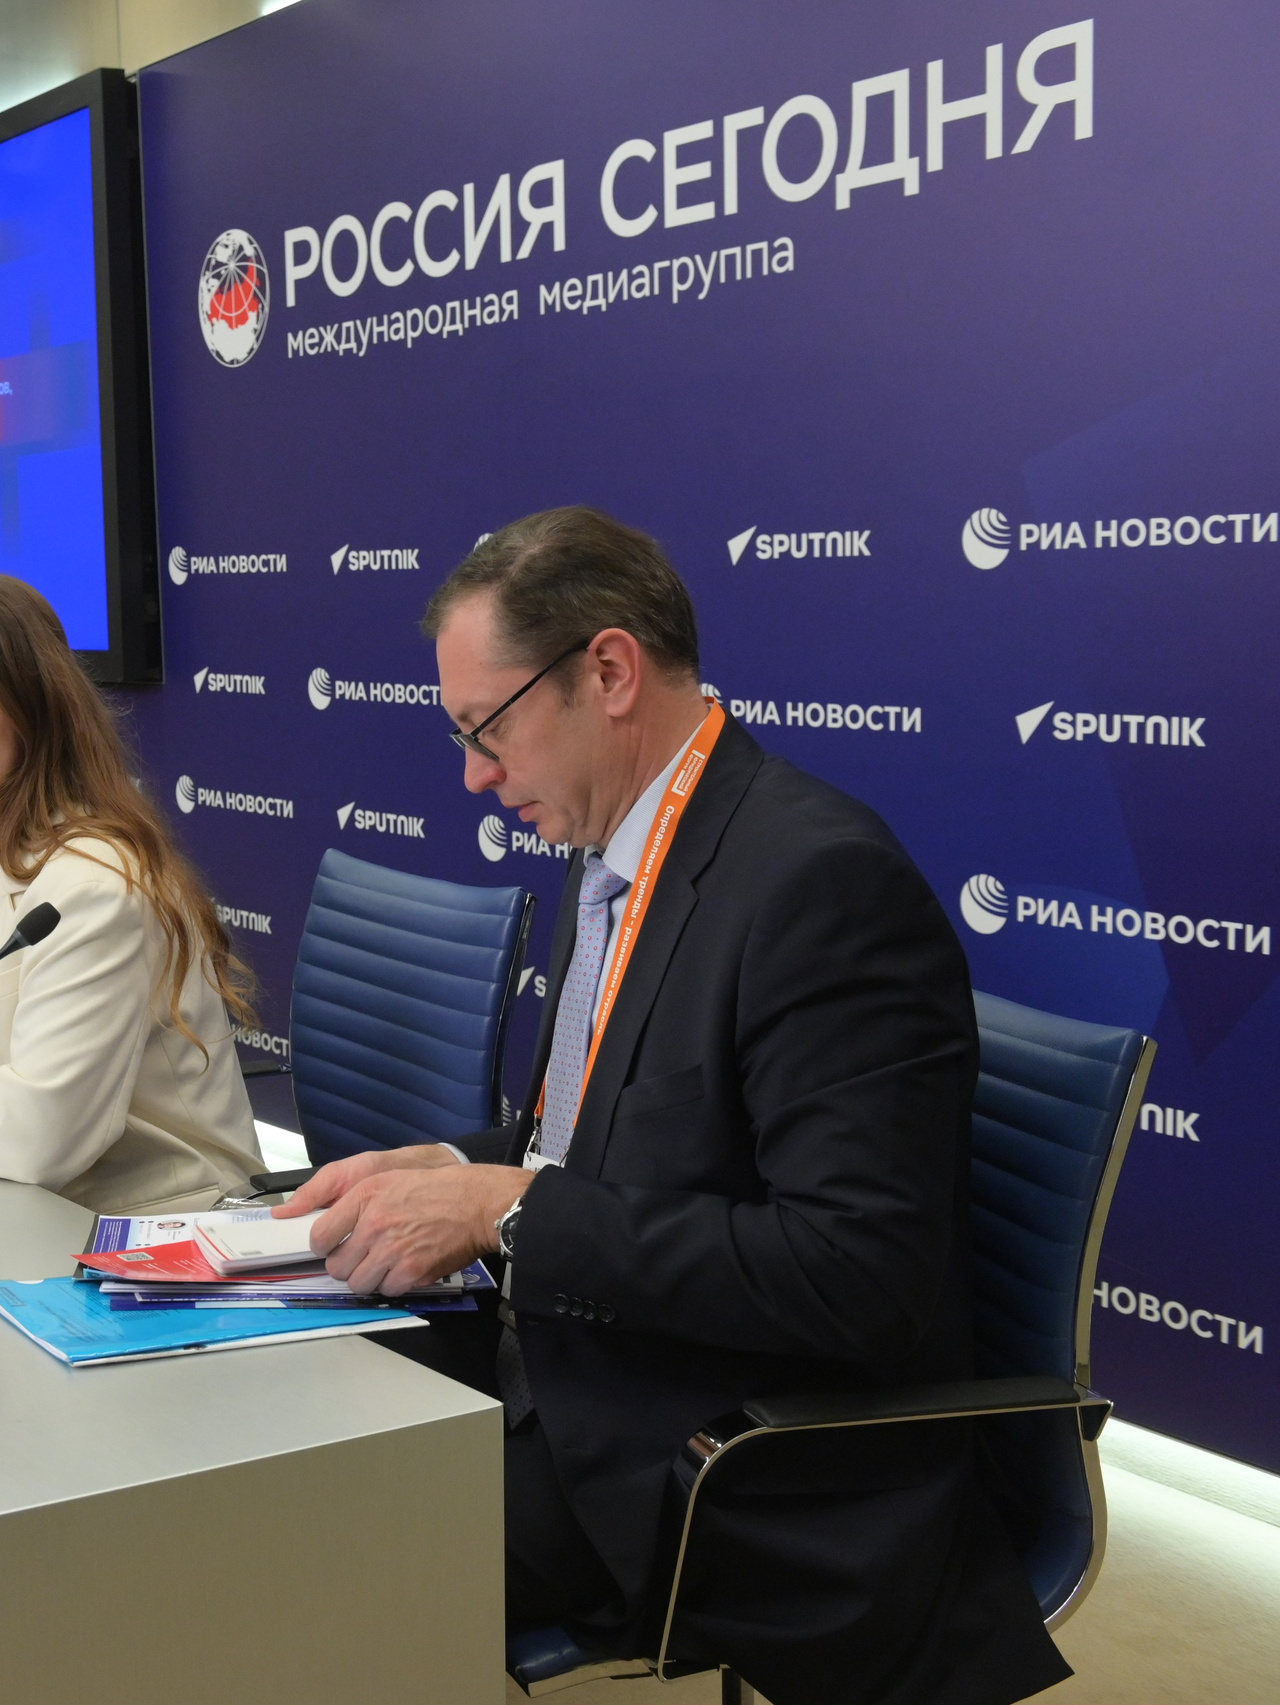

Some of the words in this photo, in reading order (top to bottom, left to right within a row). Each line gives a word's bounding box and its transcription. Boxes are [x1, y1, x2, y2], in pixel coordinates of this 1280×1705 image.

[284, 158, 566, 308] РОССИЯ
[600, 18, 1095, 238] СЕГОДНЯ
[287, 289, 519, 359] международная
[539, 236, 795, 315] медиагруппа
[755, 530, 872, 560] SPUTNIK
[1019, 521, 1087, 551] РИА
[1095, 512, 1279, 549] НОВОСТИ
[190, 556, 217, 574] РИА
[219, 554, 287, 574] НОВОСТИ
[348, 548, 420, 571] SPUTNIK
[207, 673, 266, 695] SPUTNIK
[335, 680, 368, 702] РИА
[370, 683, 443, 706] НОВОСТ
[730, 699, 781, 725] РИА
[786, 701, 922, 733] НОВОСТИ
[1052, 711, 1207, 747] SPUTNIK
[197, 787, 224, 809] РИА
[225, 792, 294, 819] НОВОСТИ
[354, 809, 425, 839] SPUTNIK
[644, 805, 675, 875] Определяем
[511, 831, 552, 857] РИА
[630, 875, 649, 918] тренды
[1016, 895, 1084, 931] РИА
[1090, 904, 1271, 956] НОВОСТИ
[611, 926, 633, 989] развиваем
[232, 1023, 290, 1057] НОВОСТ
